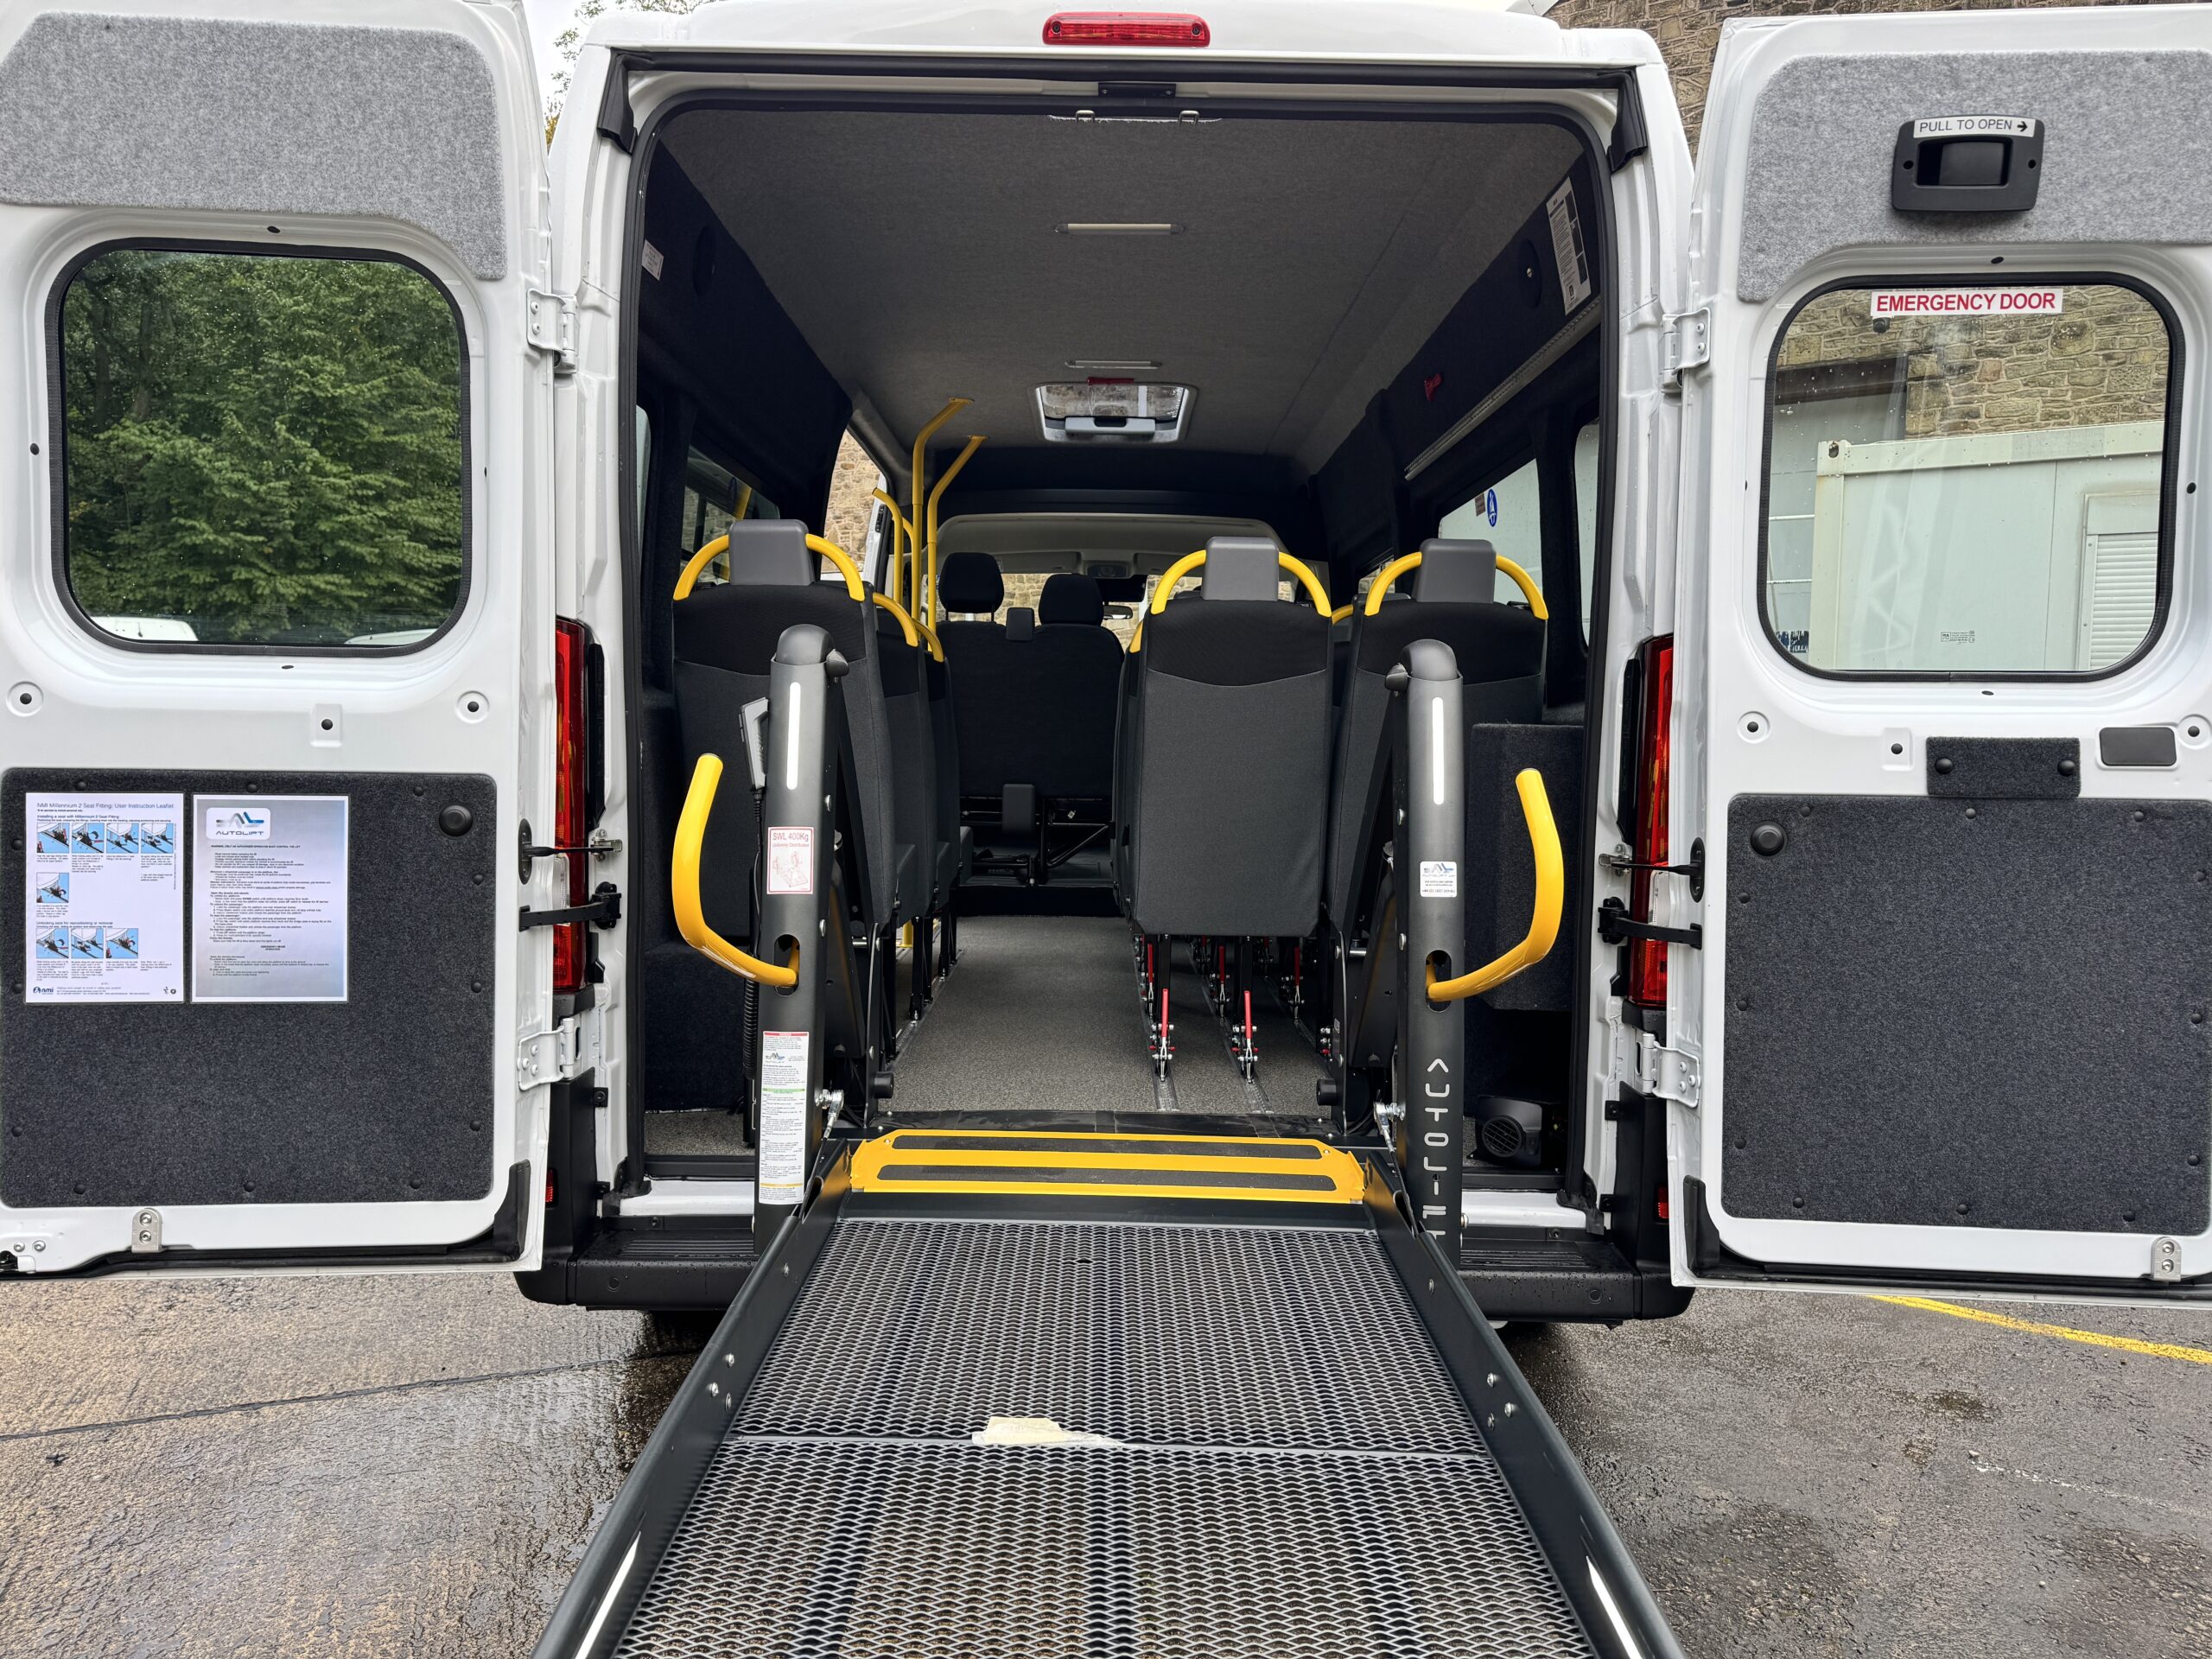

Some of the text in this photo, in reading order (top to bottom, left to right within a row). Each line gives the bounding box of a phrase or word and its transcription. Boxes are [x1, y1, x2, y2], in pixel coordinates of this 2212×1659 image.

[1919, 118, 2012, 132] PULL TO OPEN
[1876, 292, 2056, 312] EMERGENCY DOOR
[772, 832, 786, 841] SWL
